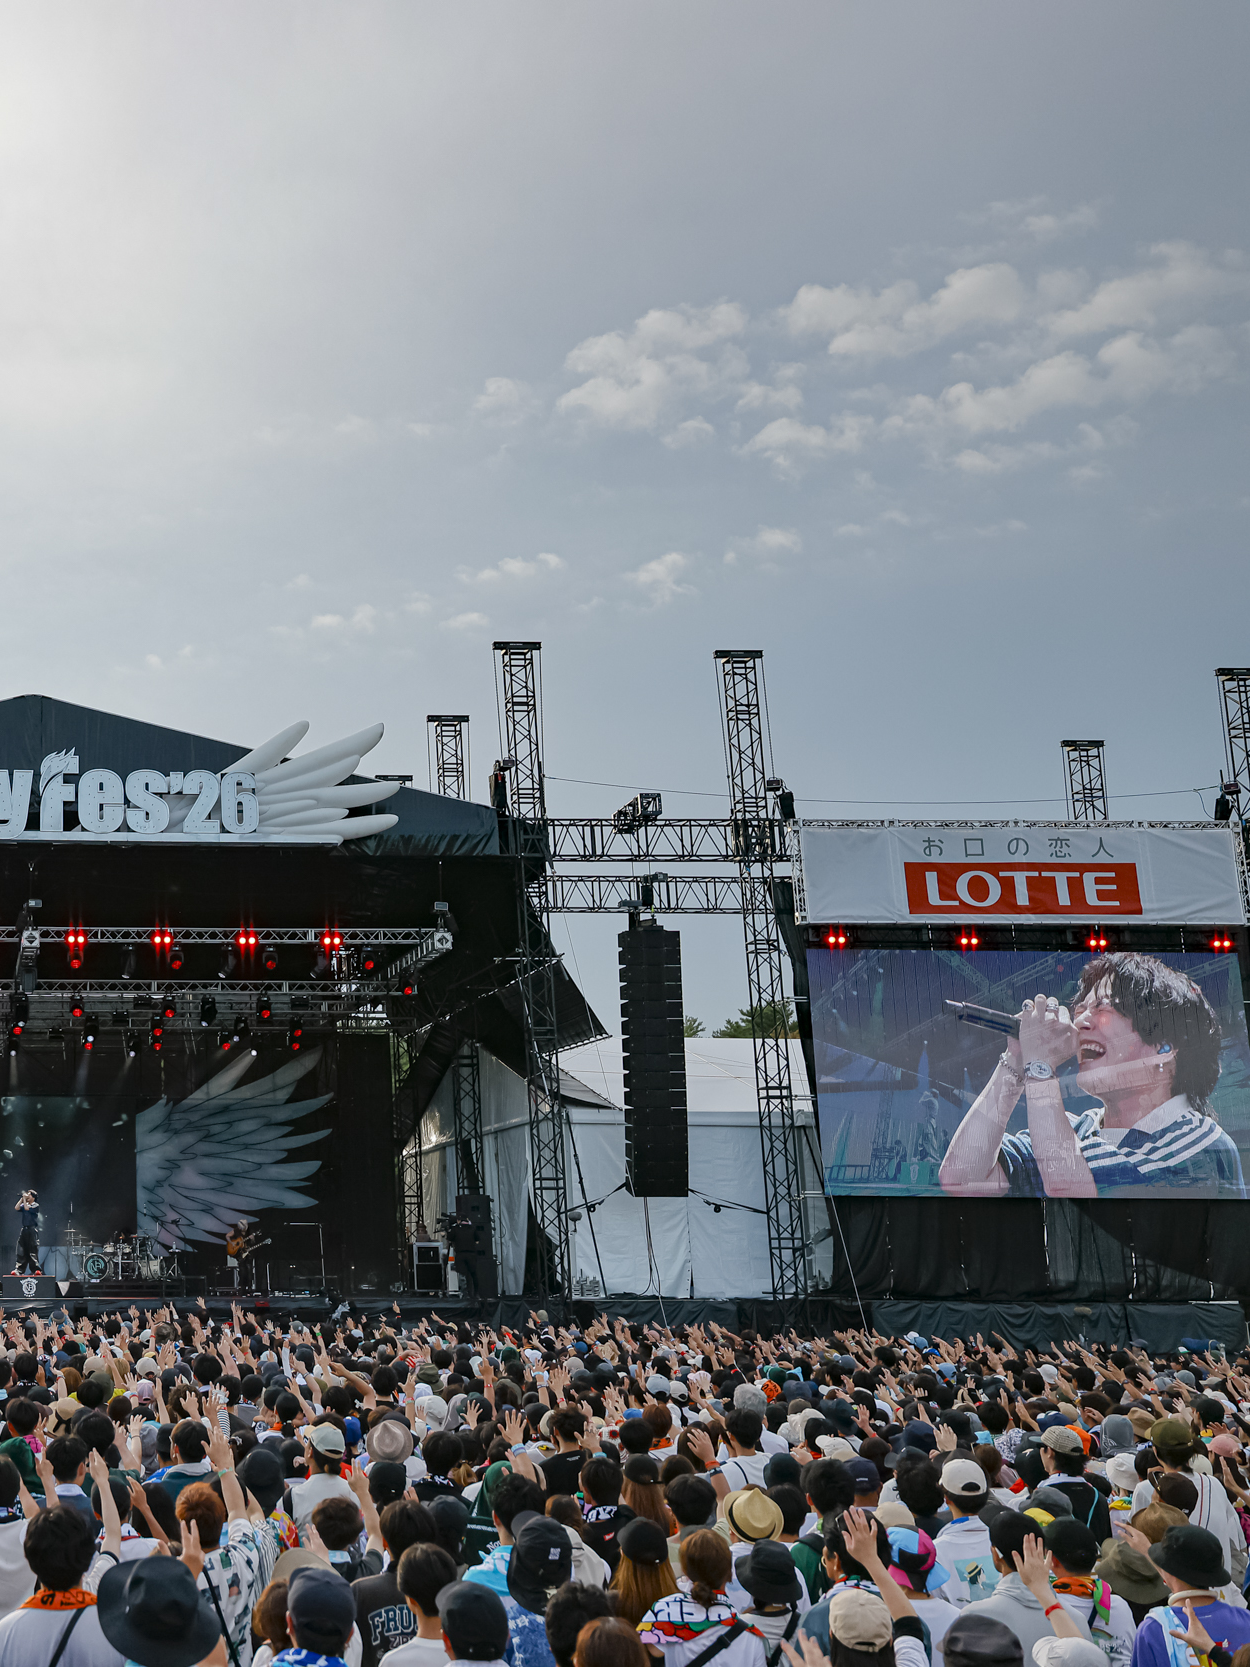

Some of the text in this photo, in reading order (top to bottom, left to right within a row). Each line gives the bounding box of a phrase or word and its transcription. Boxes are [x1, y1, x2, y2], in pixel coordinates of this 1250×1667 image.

[922, 836, 1114, 858] お口の恋人
[925, 870, 1120, 907] LOTTE
[367, 1604, 419, 1646] FRU
